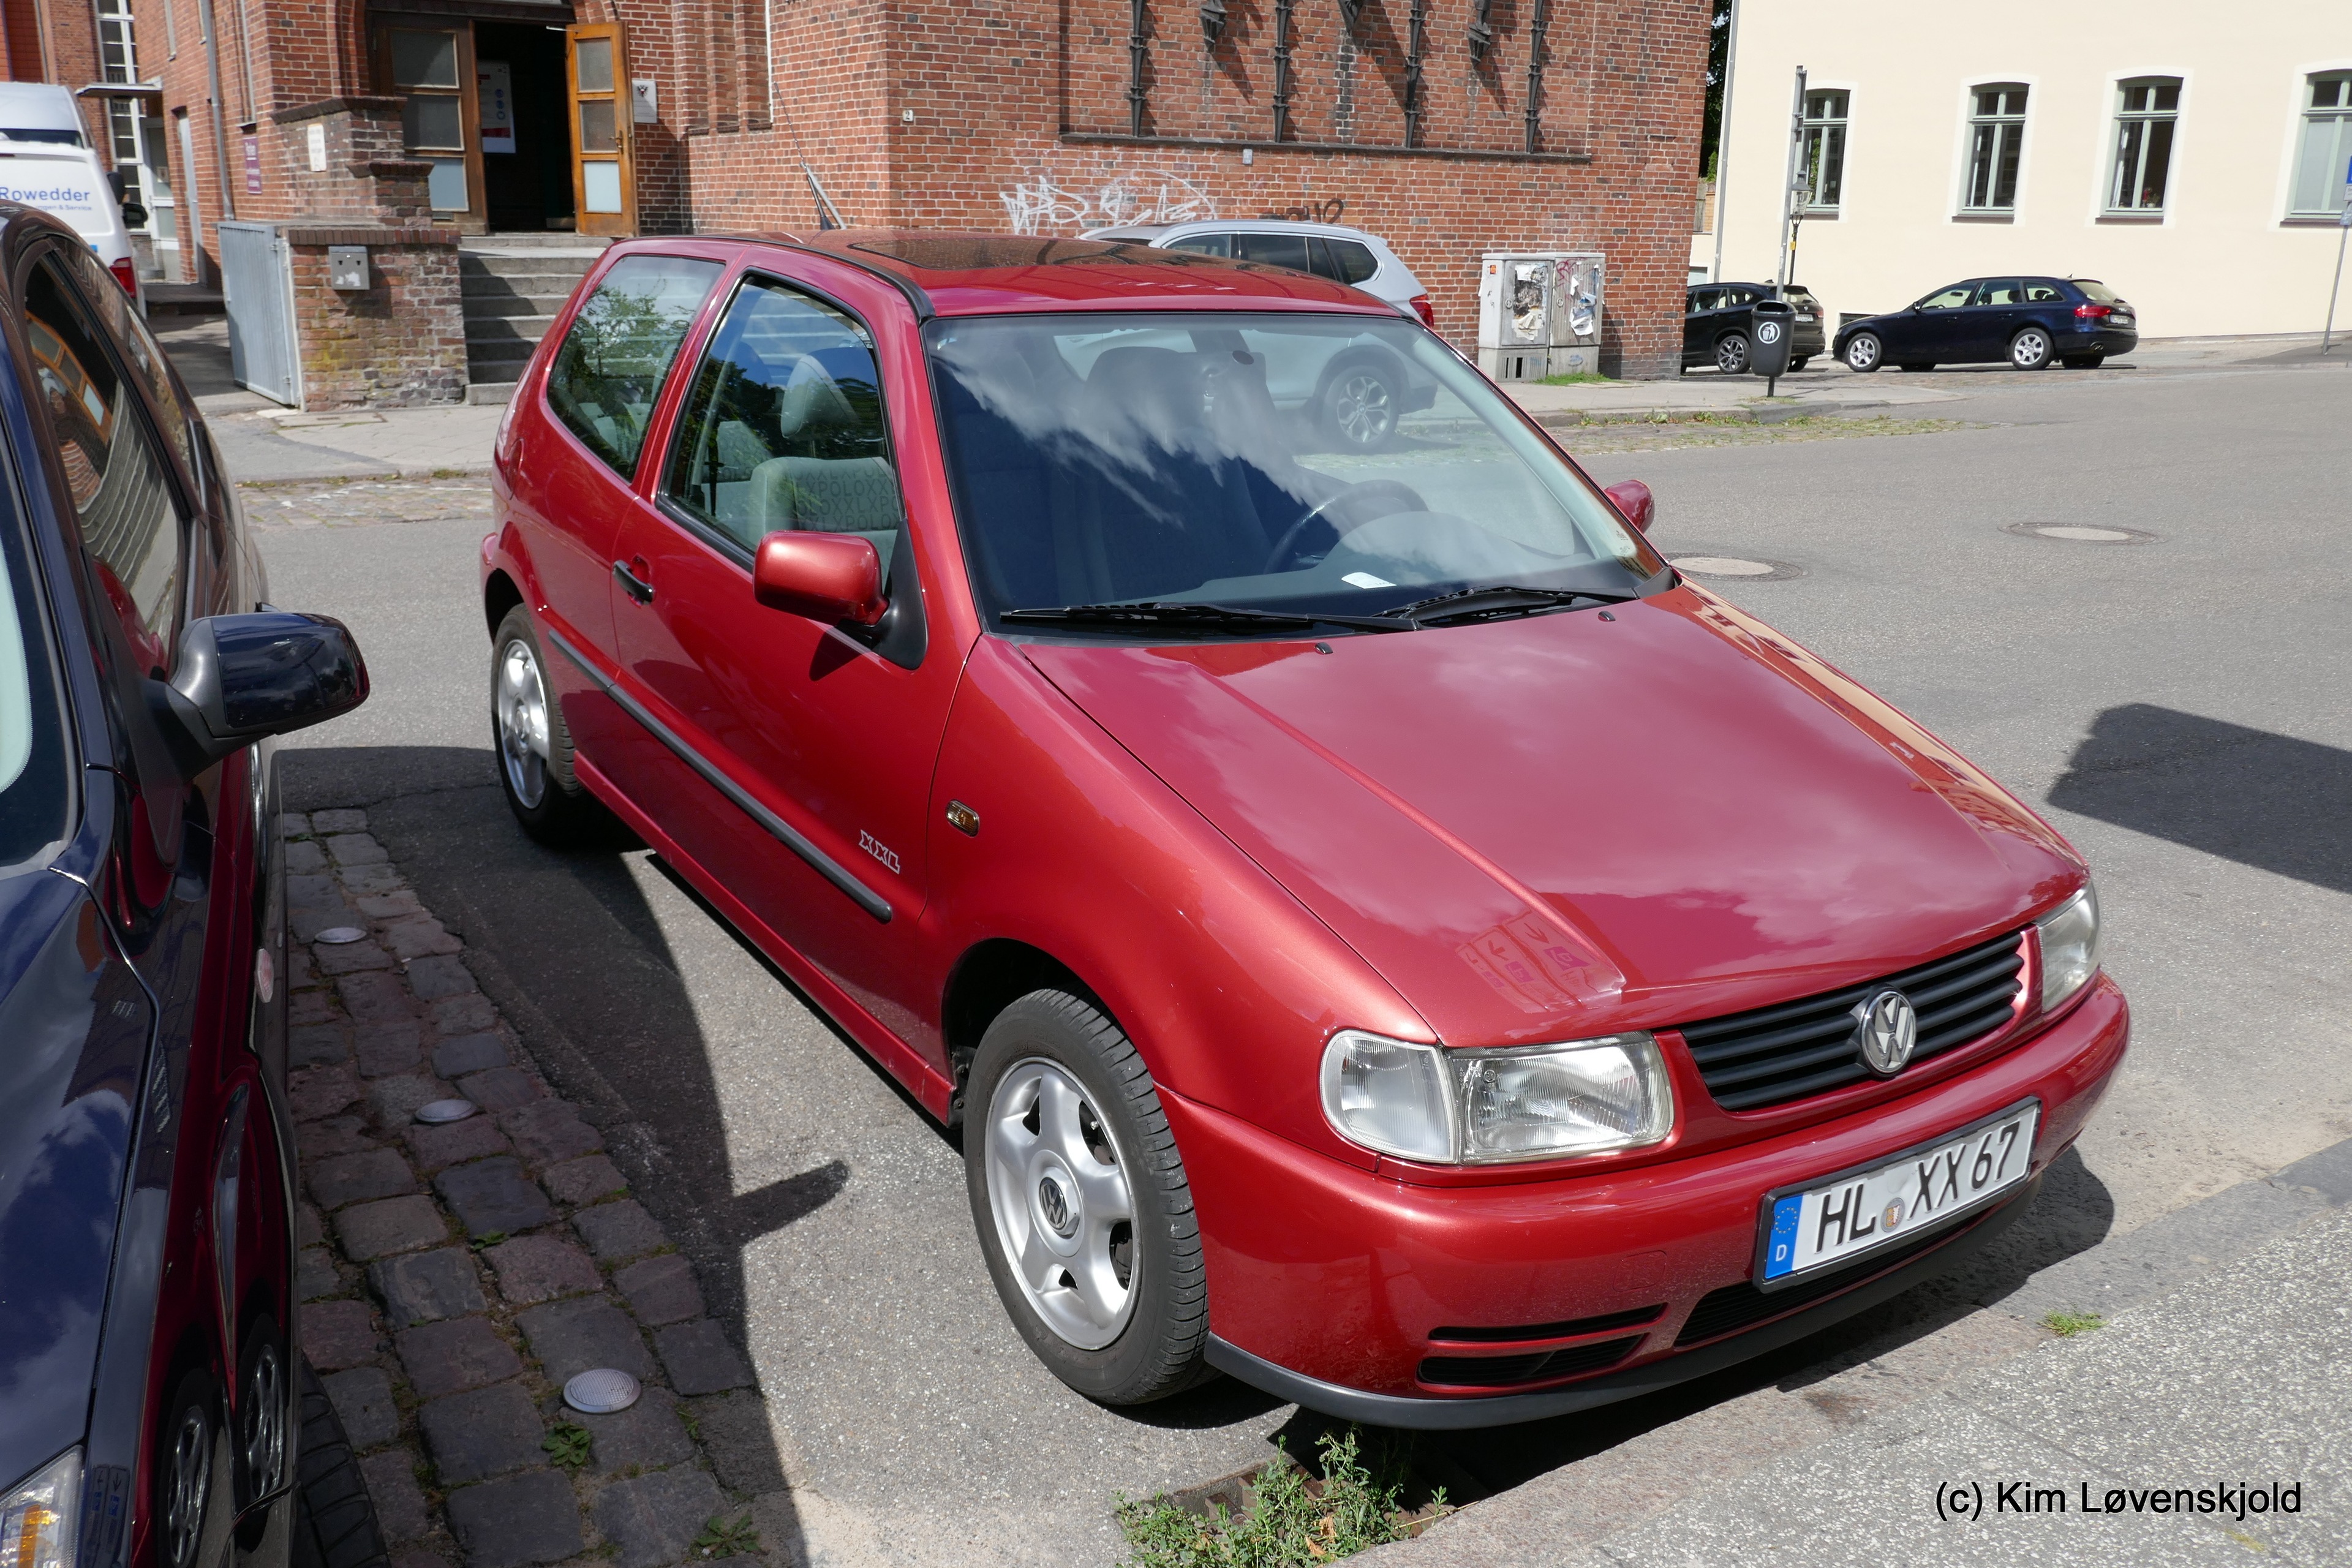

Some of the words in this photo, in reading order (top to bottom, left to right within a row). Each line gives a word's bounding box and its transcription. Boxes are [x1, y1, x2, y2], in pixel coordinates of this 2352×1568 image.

[905, 111, 910, 120] 2
[0, 187, 90, 201] Rowedder
[859, 829, 900, 875] XXL
[1862, 991, 1916, 1073] VW
[1815, 1183, 1877, 1254] HL
[1776, 1244, 1787, 1262] D
